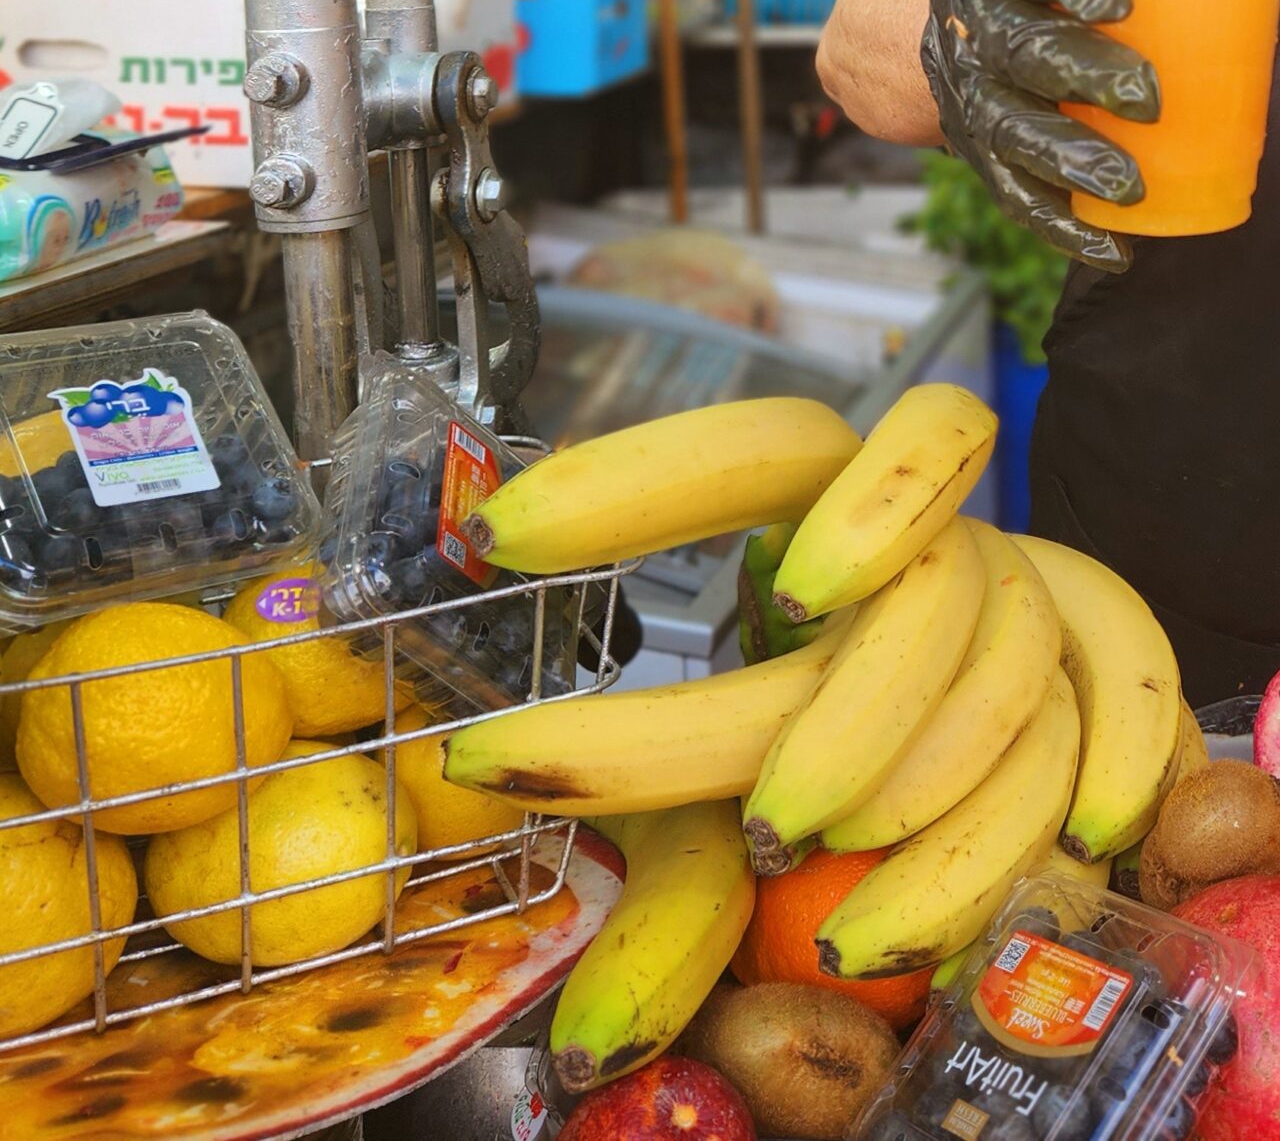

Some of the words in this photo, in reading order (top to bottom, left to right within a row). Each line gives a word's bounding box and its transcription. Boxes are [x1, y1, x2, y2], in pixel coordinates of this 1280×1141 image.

[119, 56, 245, 86] פירות
[3, 121, 29, 148] OPEN
[1010, 990, 1067, 1024] BLUEBERRIES
[1005, 1008, 1050, 1039] Sweet
[944, 1040, 1048, 1117] FruitArt
